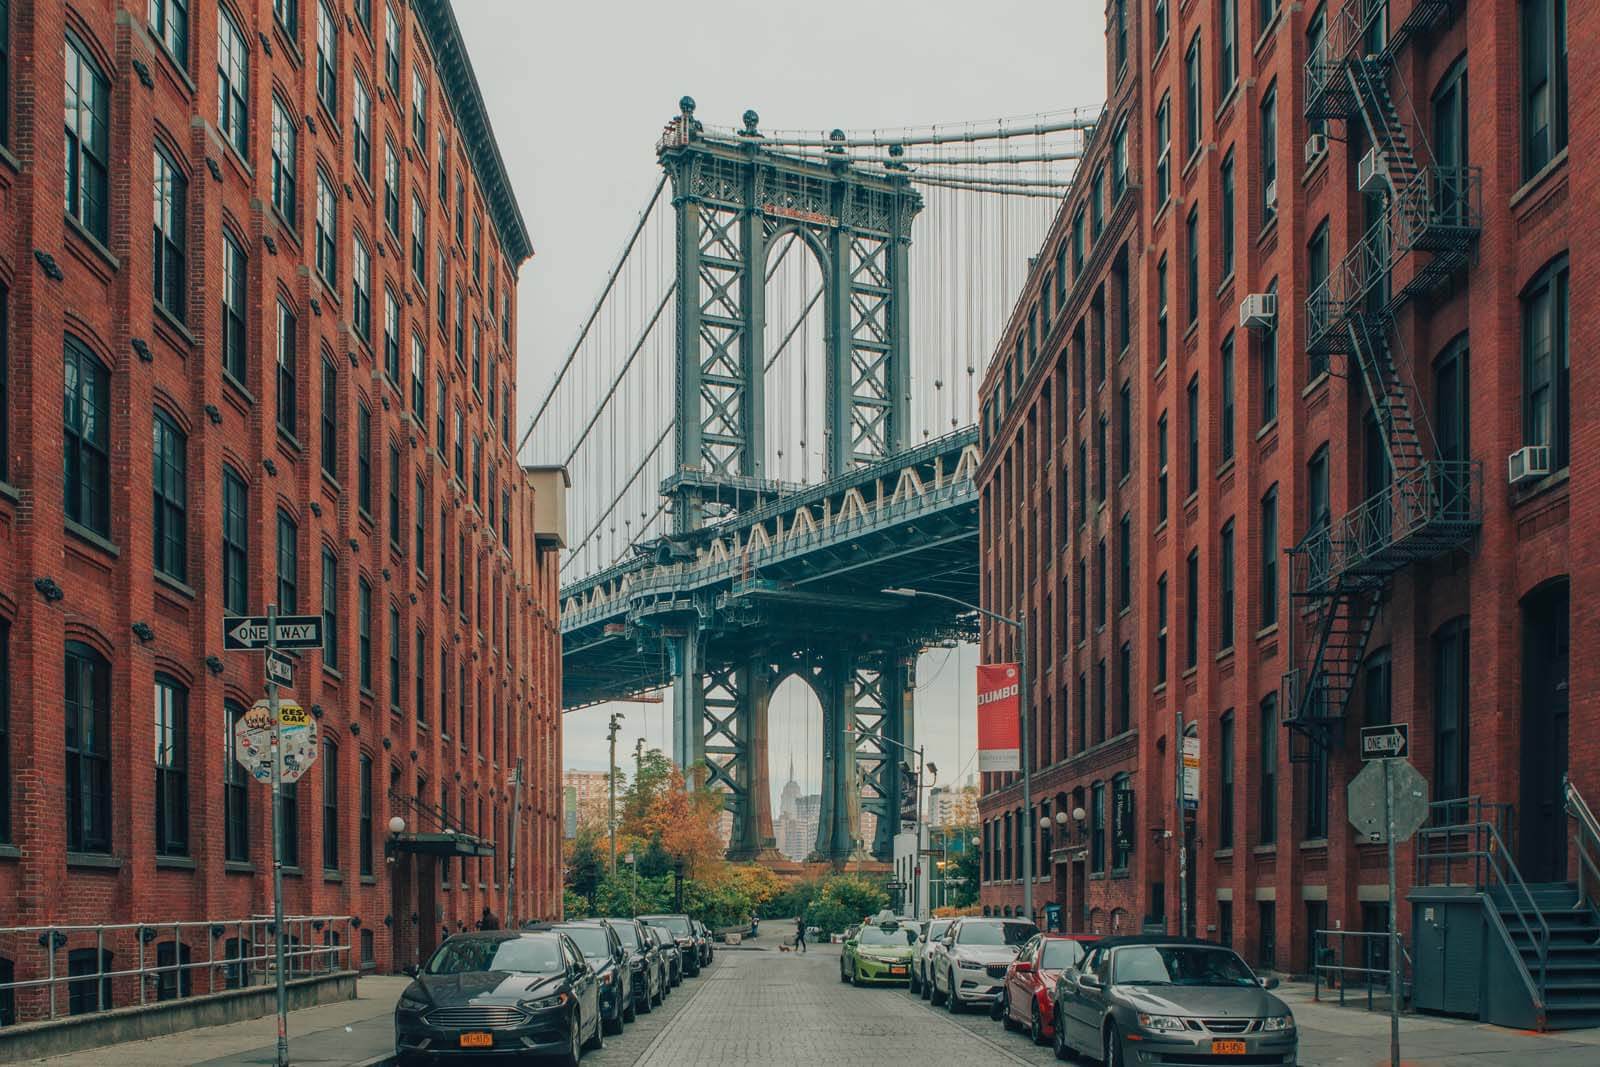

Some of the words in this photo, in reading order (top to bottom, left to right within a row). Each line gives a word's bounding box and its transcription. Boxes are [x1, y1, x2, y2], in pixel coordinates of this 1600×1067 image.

[240, 627, 267, 640] ONE
[280, 626, 310, 639] WAY
[977, 683, 1018, 705] DUMBO
[1368, 736, 1381, 750] ONE
[1388, 735, 1400, 750] WAY
